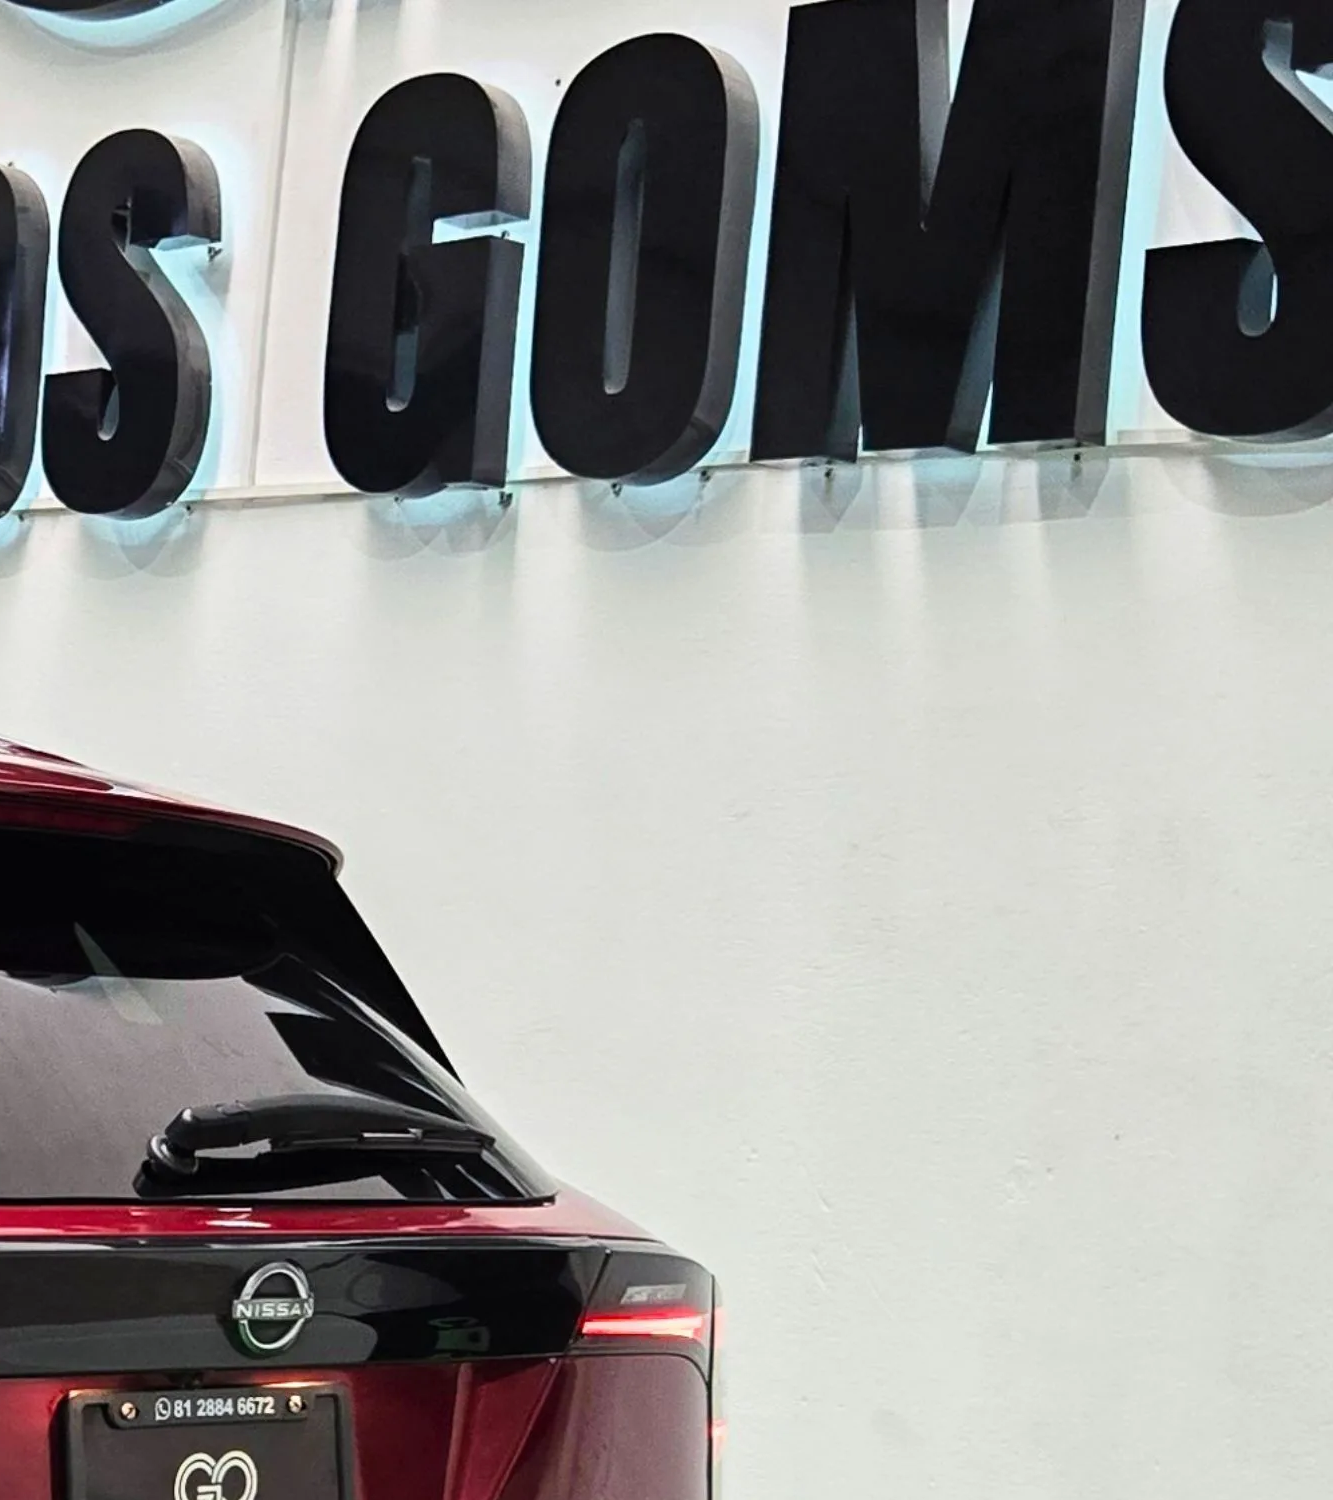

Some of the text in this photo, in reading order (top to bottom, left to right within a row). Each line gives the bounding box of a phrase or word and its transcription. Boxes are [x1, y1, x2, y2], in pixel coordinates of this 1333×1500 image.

[235, 1301, 314, 1318] NISSAN
[173, 1396, 275, 1418] 81 2884 6672
